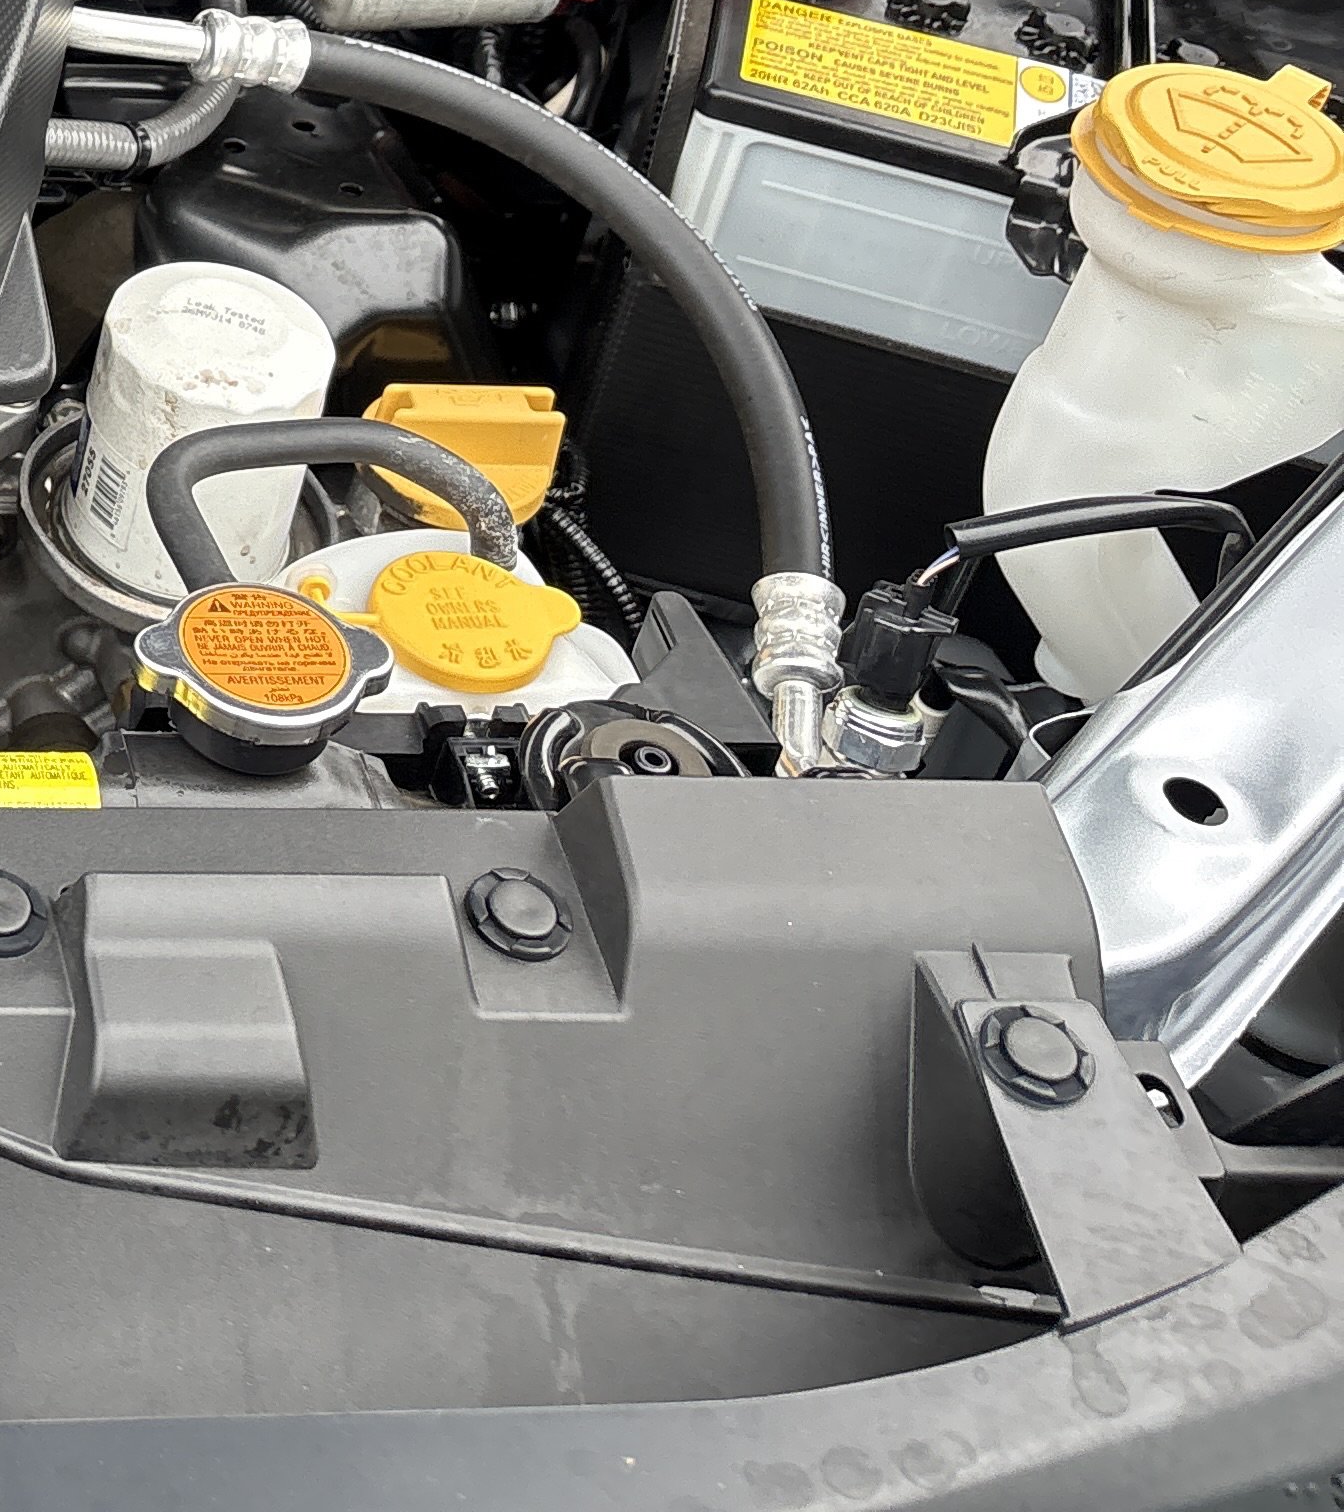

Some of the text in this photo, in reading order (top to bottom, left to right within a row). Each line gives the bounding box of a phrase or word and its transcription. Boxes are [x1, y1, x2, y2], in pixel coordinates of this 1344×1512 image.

[752, 38, 824, 63] POISON
[837, 90, 871, 108] CCA
[1141, 155, 1201, 192] PULL
[186, 297, 266, 326] Leak Tested
[381, 553, 519, 595] COOLANT
[229, 600, 294, 611] WARNING
[431, 613, 510, 631] MANUAL
[194, 634, 231, 644] NEVER
[233, 634, 264, 644] OPEN
[266, 634, 302, 644] WHEN
[226, 675, 326, 686] AVERTISSEMENT
